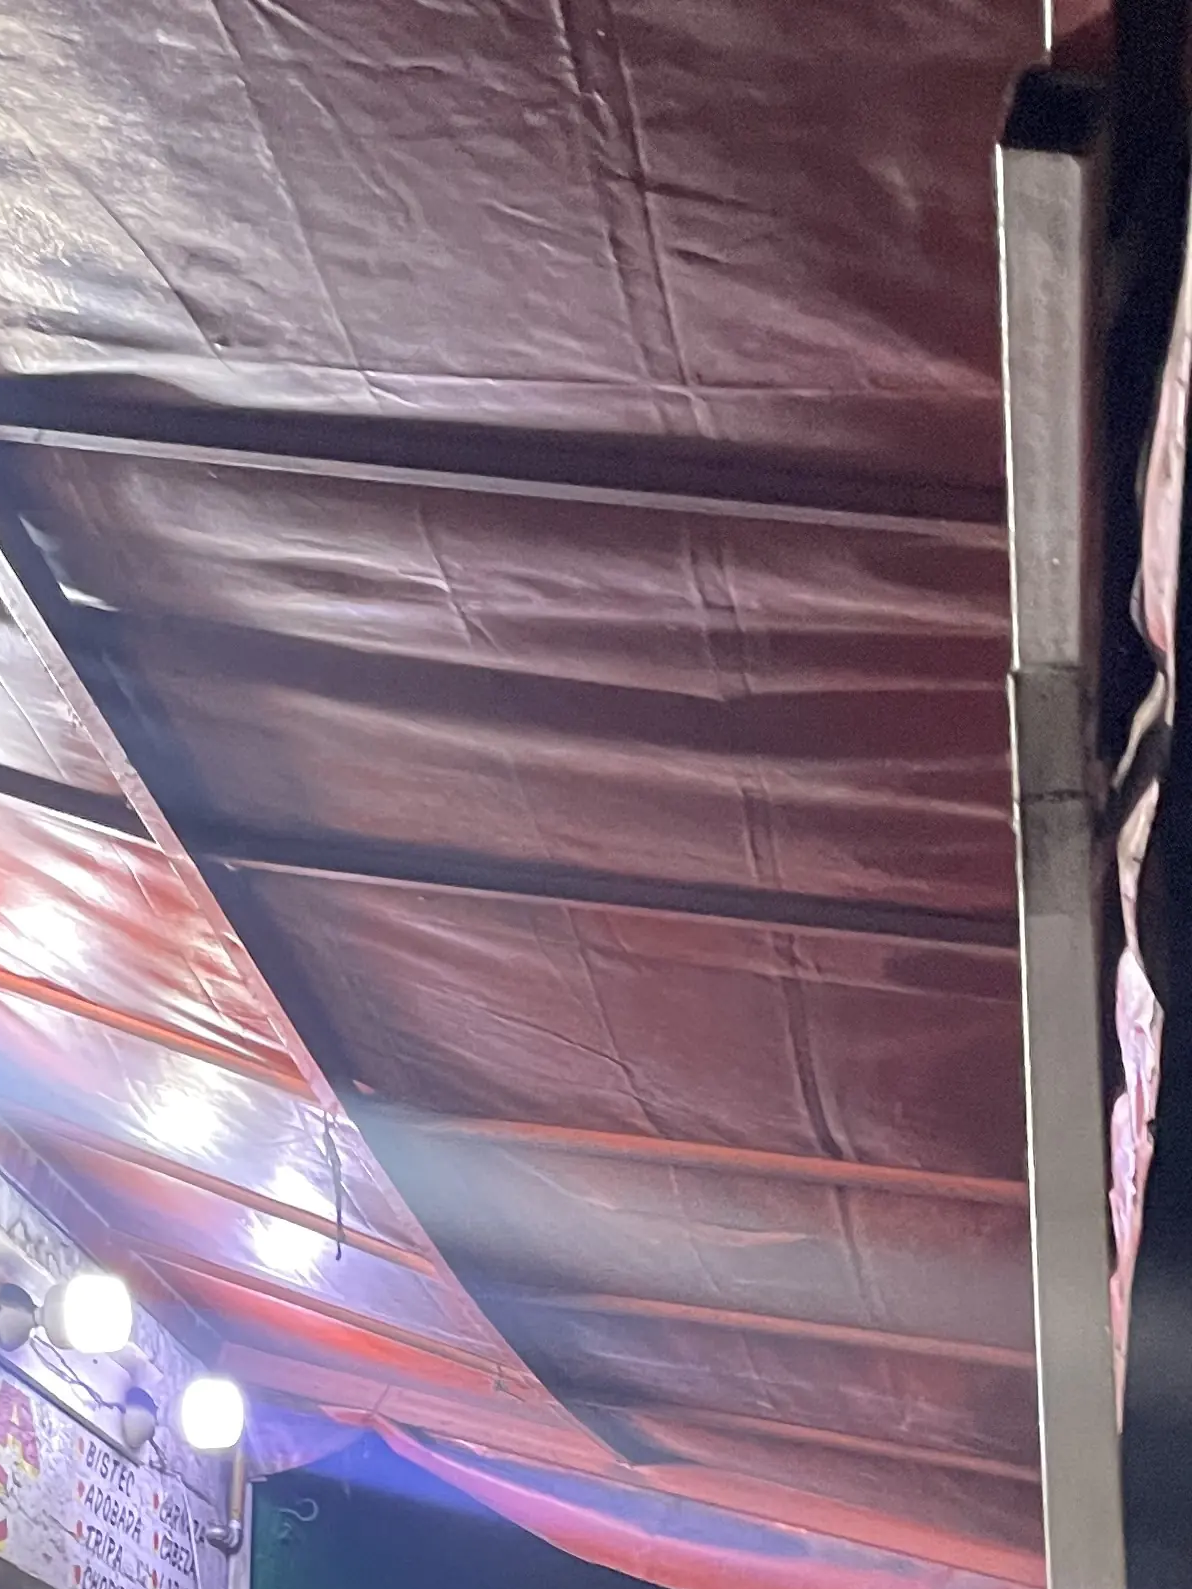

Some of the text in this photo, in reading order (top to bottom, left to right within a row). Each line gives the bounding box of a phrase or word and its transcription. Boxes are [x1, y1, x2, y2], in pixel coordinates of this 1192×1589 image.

[86, 1441, 136, 1498] BISTEC
[84, 1484, 142, 1545] ADOBADA
[85, 1525, 123, 1571] TRIPA
